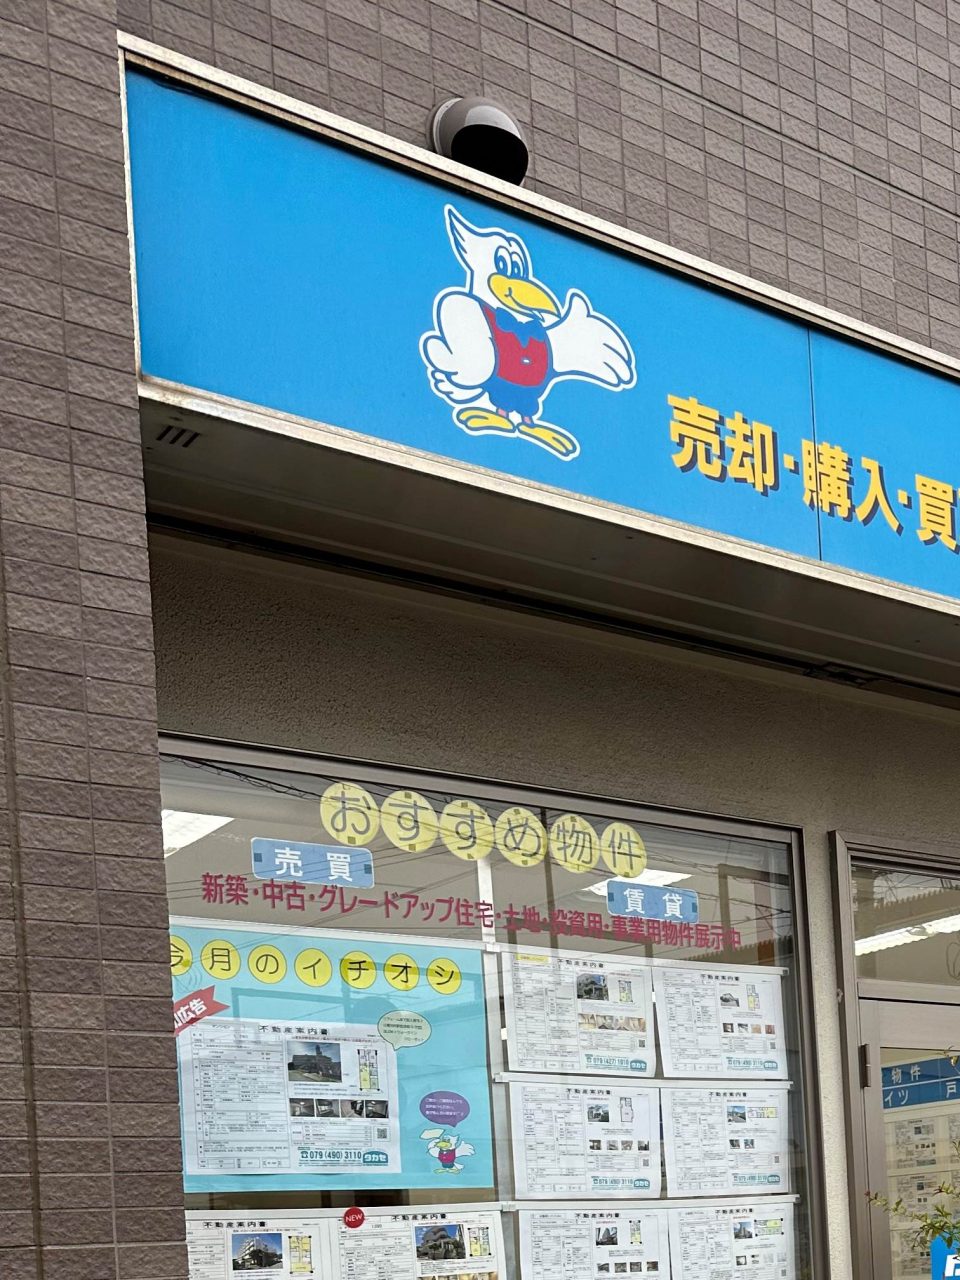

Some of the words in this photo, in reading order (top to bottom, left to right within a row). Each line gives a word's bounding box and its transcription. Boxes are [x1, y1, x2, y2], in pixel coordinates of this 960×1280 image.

[329, 789, 643, 870] おすすめ物件
[274, 847, 353, 882] 売買
[623, 887, 683, 918] 賃貸
[259, 1025, 328, 1035] 不動産案内書
[891, 1067, 921, 1084] 物件
[309, 1151, 323, 1159] 079
[324, 1151, 343, 1159] (490)
[344, 1151, 361, 1159] 3110
[345, 1213, 363, 1222] NEW
